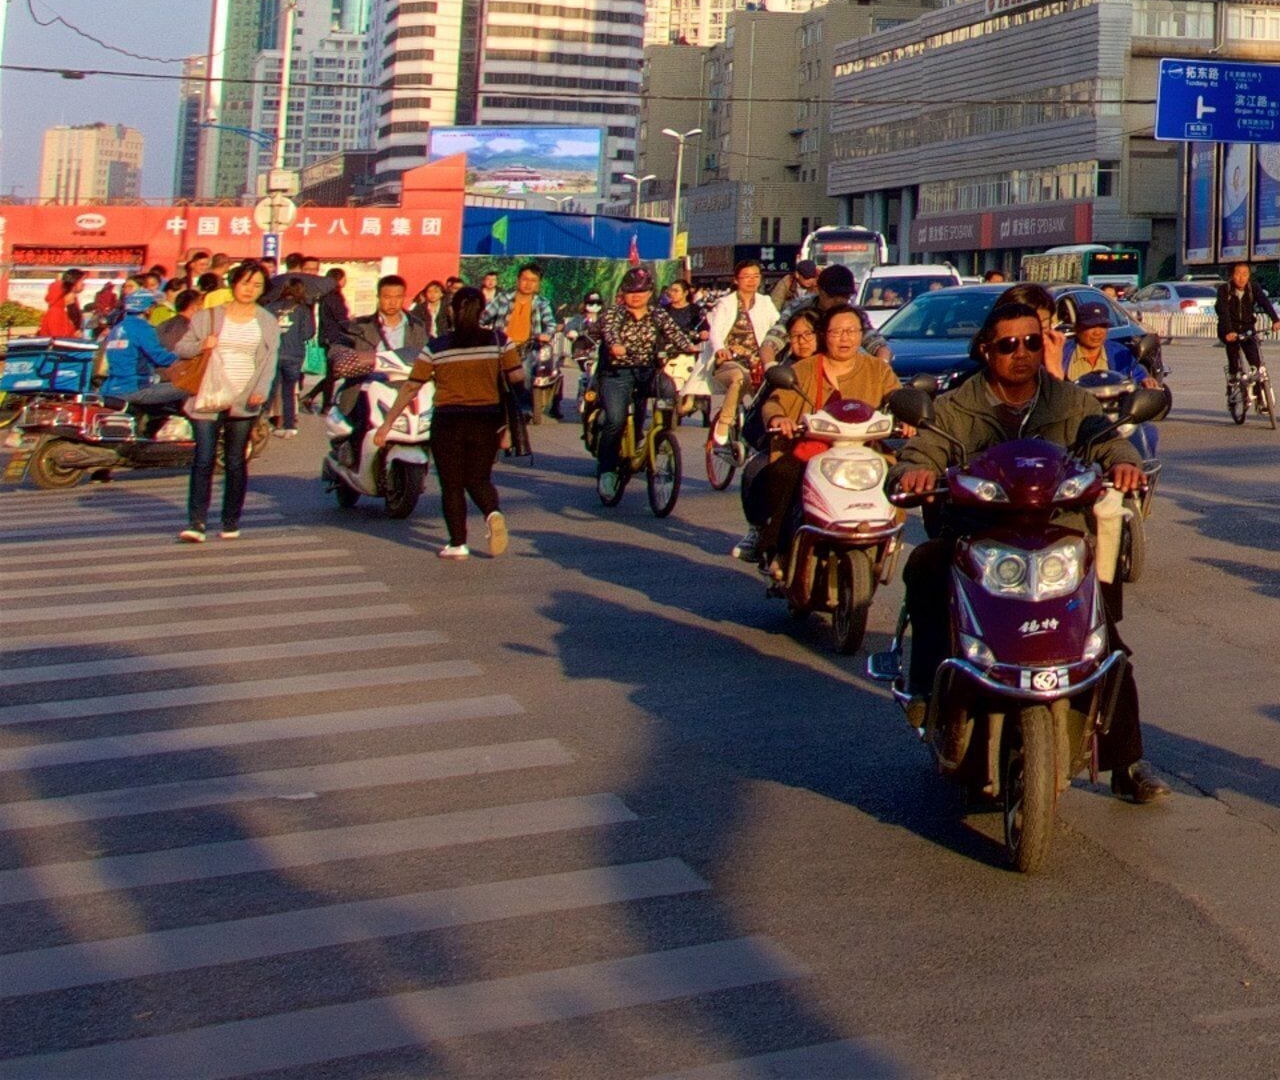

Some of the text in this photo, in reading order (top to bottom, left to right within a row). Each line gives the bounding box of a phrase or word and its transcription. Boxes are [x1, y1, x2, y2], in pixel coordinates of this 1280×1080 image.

[1186, 66, 1219, 80] 拓东路
[1234, 94, 1268, 108] 滨江路
[165, 215, 442, 236] 中国铁十八局集团
